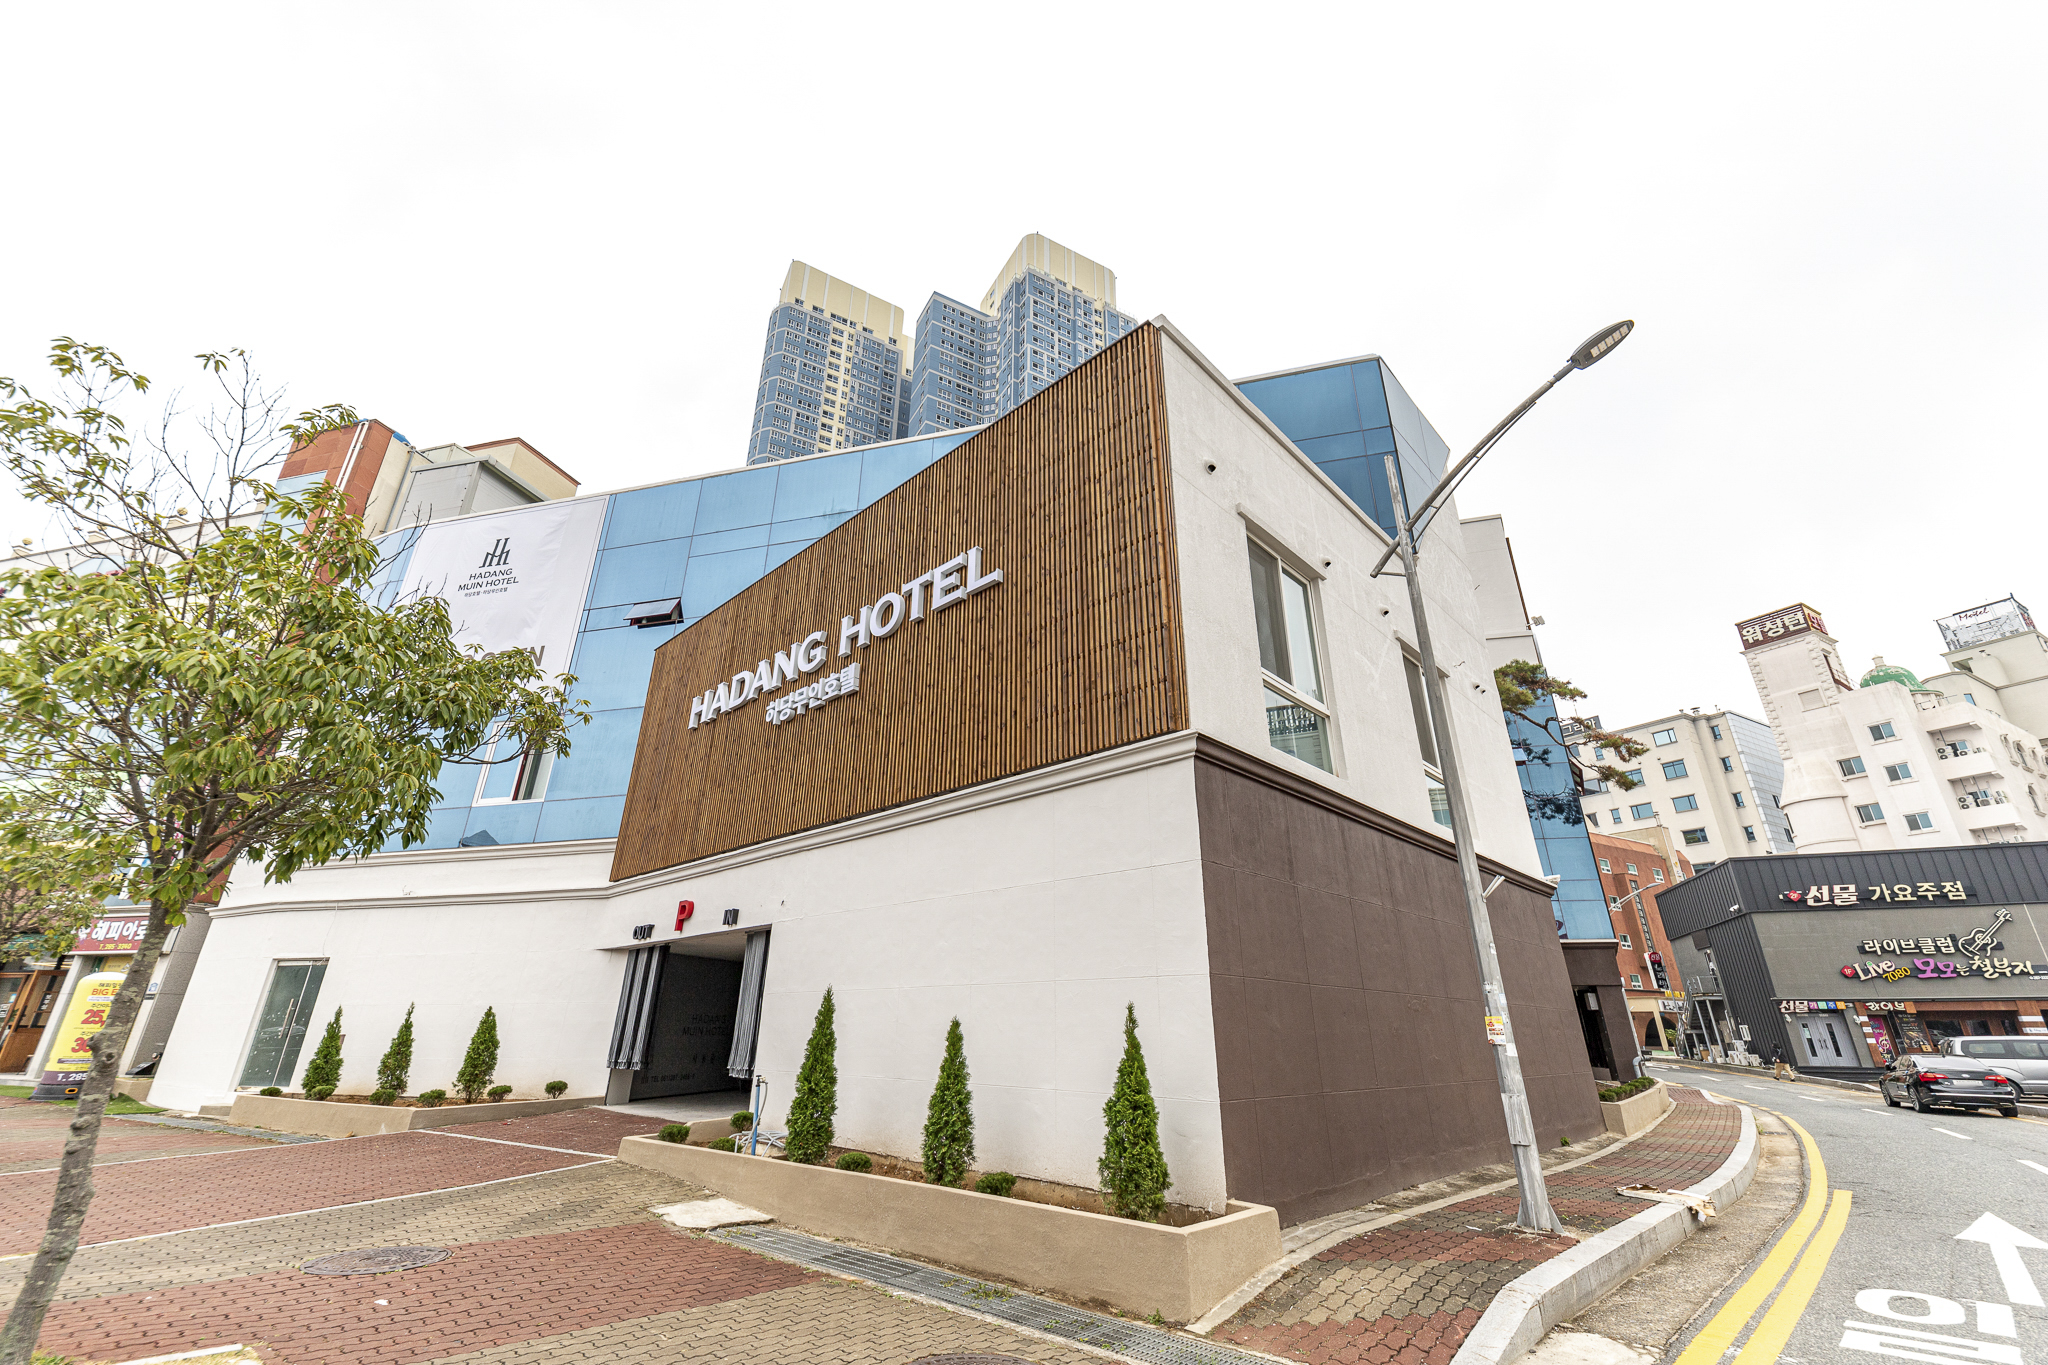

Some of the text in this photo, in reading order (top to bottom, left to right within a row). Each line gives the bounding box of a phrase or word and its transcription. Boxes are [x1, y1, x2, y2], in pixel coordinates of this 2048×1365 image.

[457, 576, 519, 592] MUIN HOTEL
[469, 568, 513, 581] HADANG
[688, 545, 1004, 730] HADANG HOTEL
[765, 662, 861, 725] 하당무인호텔
[1803, 880, 1967, 907] 선물 가요주점
[674, 899, 694, 932] P
[722, 908, 739, 926] IN
[632, 924, 655, 940] OUT
[1862, 937, 1956, 956] 라이브클럽
[1852, 960, 1911, 983] Live 7080
[1969, 955, 2035, 979] 철부지
[91, 988, 109, 996] BIG
[1779, 1001, 1810, 1013] 선물
